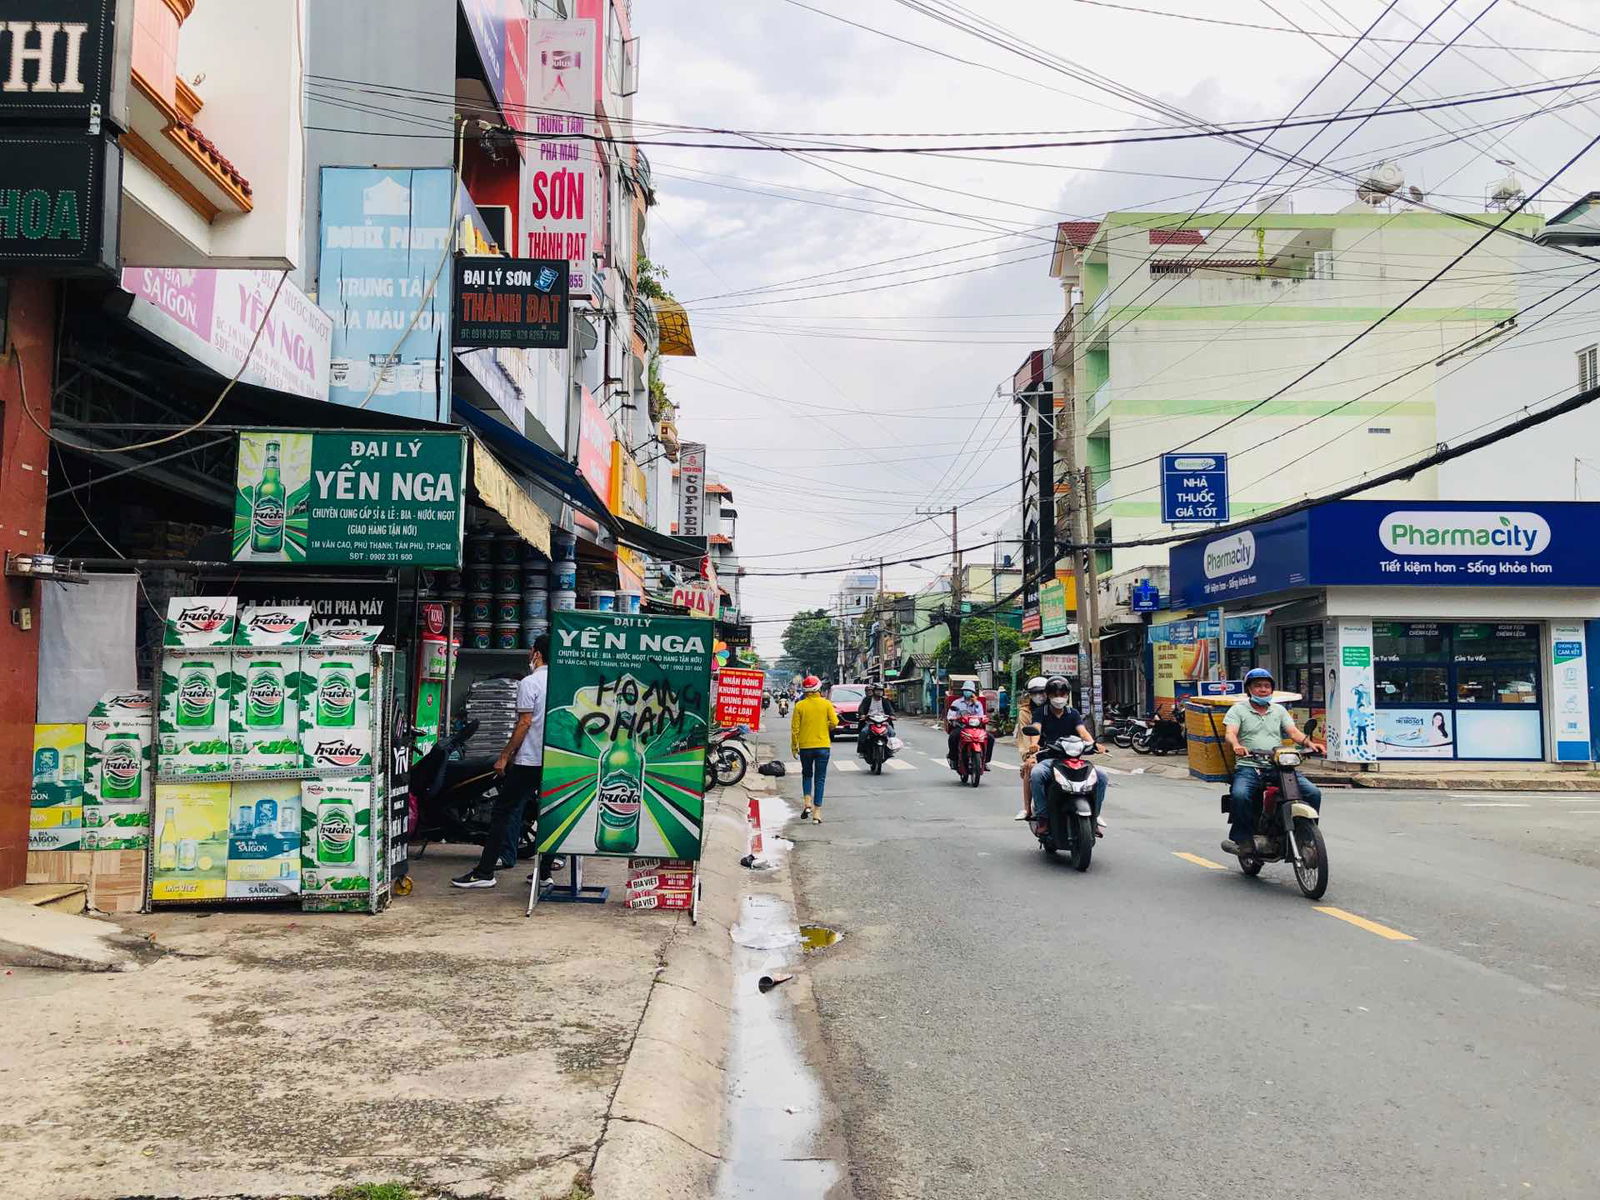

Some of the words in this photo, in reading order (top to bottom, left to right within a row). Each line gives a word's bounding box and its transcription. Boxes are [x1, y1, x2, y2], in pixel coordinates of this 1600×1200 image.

[0, 21, 88, 92] HI
[537, 116, 564, 133] TRUNG
[540, 143, 557, 161] PHA
[532, 167, 585, 220] SƠN
[528, 226, 563, 260] THÀNH
[567, 232, 587, 267] ĐẠT
[164, 268, 181, 289] BIA
[463, 269, 485, 288] ĐẠI
[488, 267, 503, 286] LÝ
[506, 269, 532, 287] SƠN
[461, 286, 522, 323] THÀNH
[525, 293, 561, 330] ĐẠT
[351, 441, 388, 460] ĐẠI
[395, 438, 423, 458] LÝ
[315, 459, 381, 500] YẾN
[391, 472, 455, 502] NGA
[1183, 475, 1208, 488] NHÀ
[1176, 488, 1216, 503] THUỐC
[312, 507, 339, 519] CHUYÊN
[339, 509, 358, 519] CUNG
[359, 505, 372, 520] CẤP
[380, 510, 386, 519] &
[400, 509, 412, 520] BIA
[417, 507, 436, 521] NƯỚC
[437, 510, 456, 523] NGỌT
[683, 474, 699, 536] COFFEE
[1175, 505, 1195, 518] GIÁ
[1197, 503, 1218, 517] TỐT
[347, 525, 367, 536] (GIAO
[1391, 518, 1538, 551] Pharmacity
[349, 552, 364, 560] SĐT
[369, 553, 386, 561] 0902
[387, 553, 399, 561] 331
[1206, 541, 1252, 570] Pharmacity
[1379, 559, 1402, 573] Tiết
[1404, 561, 1432, 576] kiệm
[1434, 562, 1457, 573] hơn
[1467, 560, 1497, 576] Sống
[1499, 561, 1528, 573] khỏe
[1530, 562, 1553, 573] hơn
[335, 600, 357, 615] PHA
[360, 597, 384, 615] MÁY
[613, 617, 634, 628] ĐẠI
[637, 616, 652, 628] LÝ
[557, 625, 627, 650] YẾN
[639, 634, 706, 653] NGA
[247, 886, 279, 894] SAIGON
[633, 880, 644, 888] BIA
[632, 900, 643, 908] BIA
